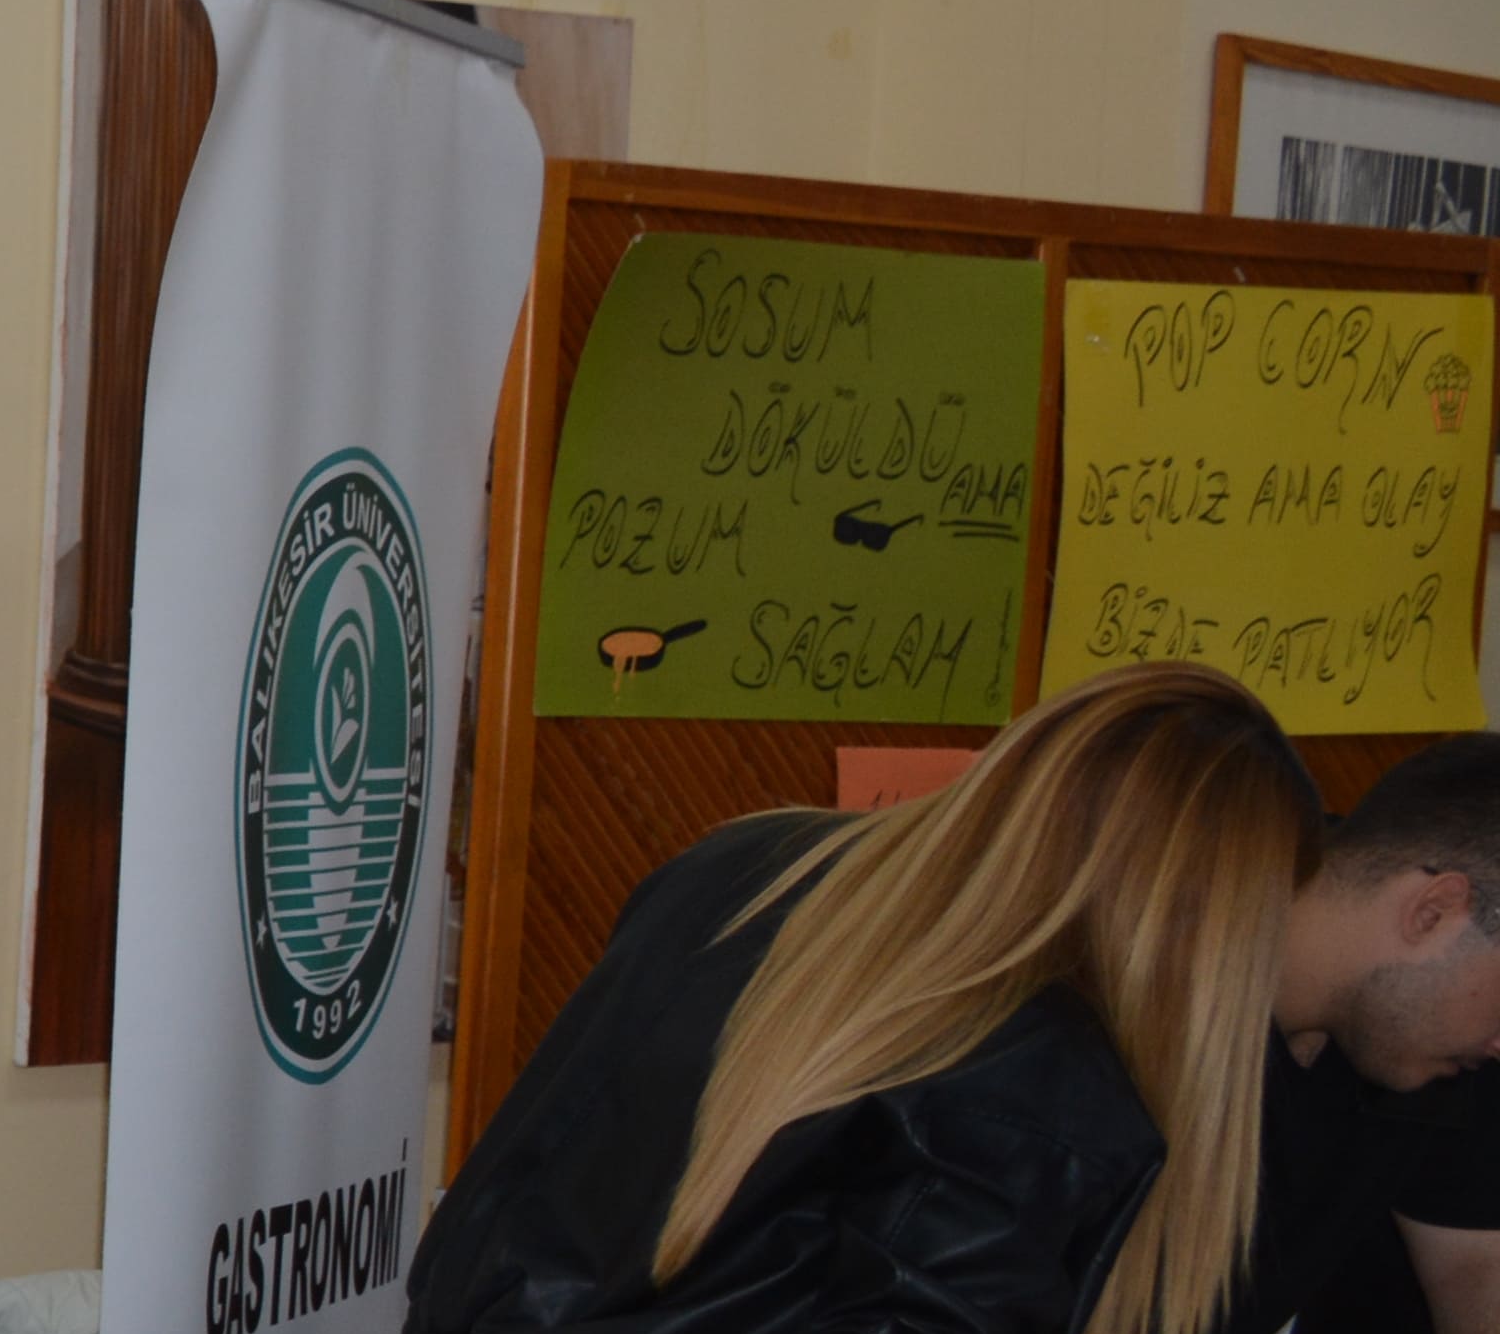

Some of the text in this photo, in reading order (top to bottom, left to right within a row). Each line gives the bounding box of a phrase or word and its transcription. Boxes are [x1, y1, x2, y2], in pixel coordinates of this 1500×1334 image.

[658, 248, 875, 363] SOSUM
[1123, 290, 1445, 435] POP CORN
[701, 381, 1027, 518] DÖKÜLDÜ AMA
[1077, 456, 1461, 559] DEĞİLİZ AMA OLAY
[560, 488, 748, 577] POZUM
[248, 482, 423, 814] BALIKESİR ÜNİVERSİTESİ
[1232, 572, 1442, 706] PATLIYOR
[293, 983, 362, 1039] 1992
